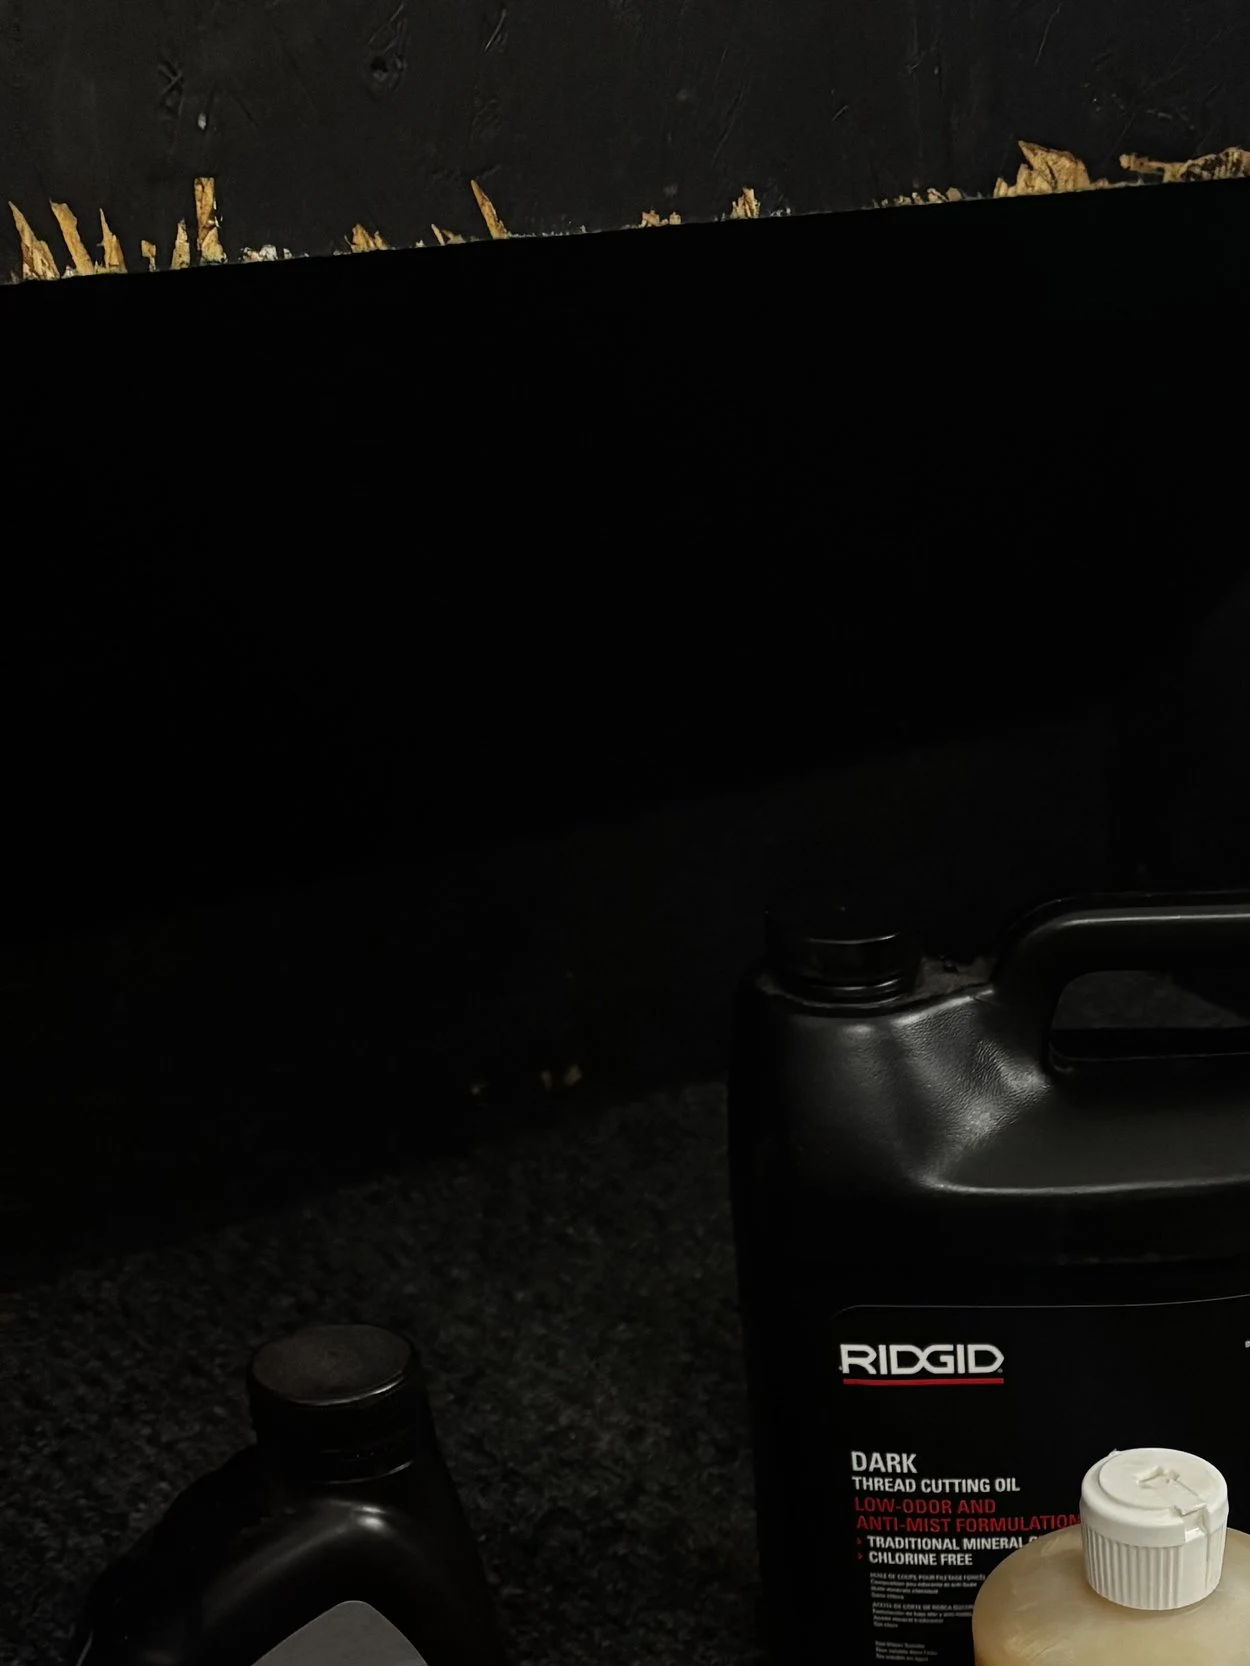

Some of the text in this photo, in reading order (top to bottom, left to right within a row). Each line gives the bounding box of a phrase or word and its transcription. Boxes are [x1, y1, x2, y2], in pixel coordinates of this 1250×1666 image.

[838, 1343, 1005, 1375] RIDGID
[850, 1450, 918, 1474] DARK
[852, 1475, 1021, 1494] THREAD CUTTING OIL
[853, 1496, 997, 1515] LOW-ODOR AND
[856, 1515, 951, 1533] ANTI-MIST
[867, 1534, 959, 1551] TRADITIONAL
[868, 1551, 973, 1567] CHLORINE FREE
